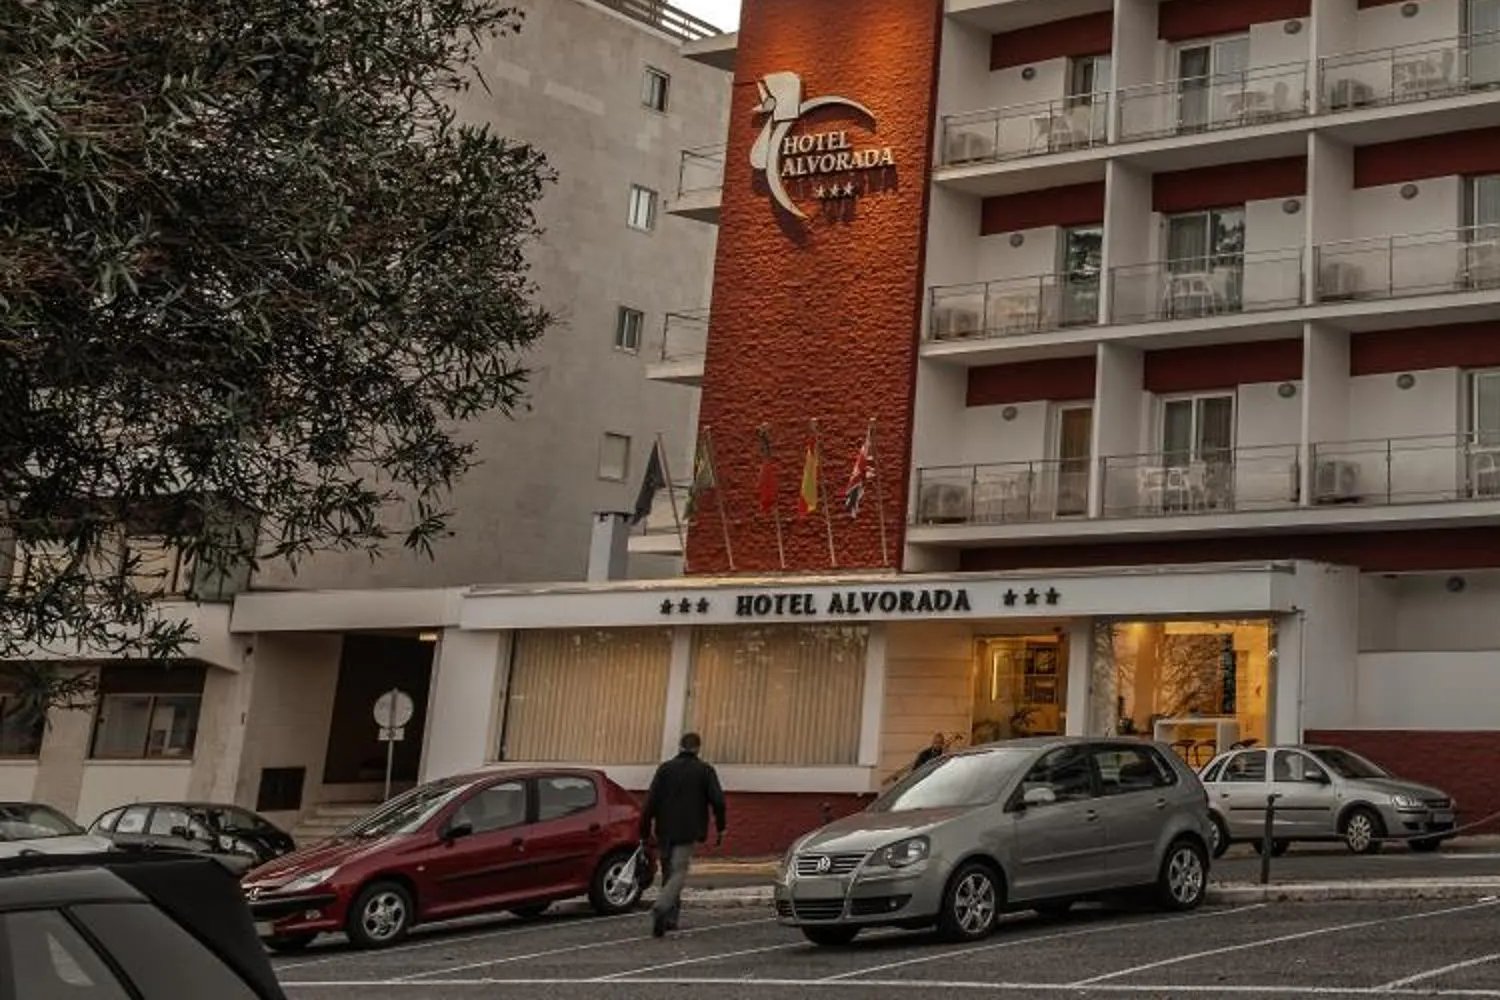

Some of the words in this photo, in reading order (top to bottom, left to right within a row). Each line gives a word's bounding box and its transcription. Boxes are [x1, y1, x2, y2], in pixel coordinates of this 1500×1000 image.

[783, 131, 851, 155] HOTEL
[781, 147, 895, 177] ALVORADA
[736, 592, 817, 617] HOTEL
[828, 589, 971, 614] ALVORADA
